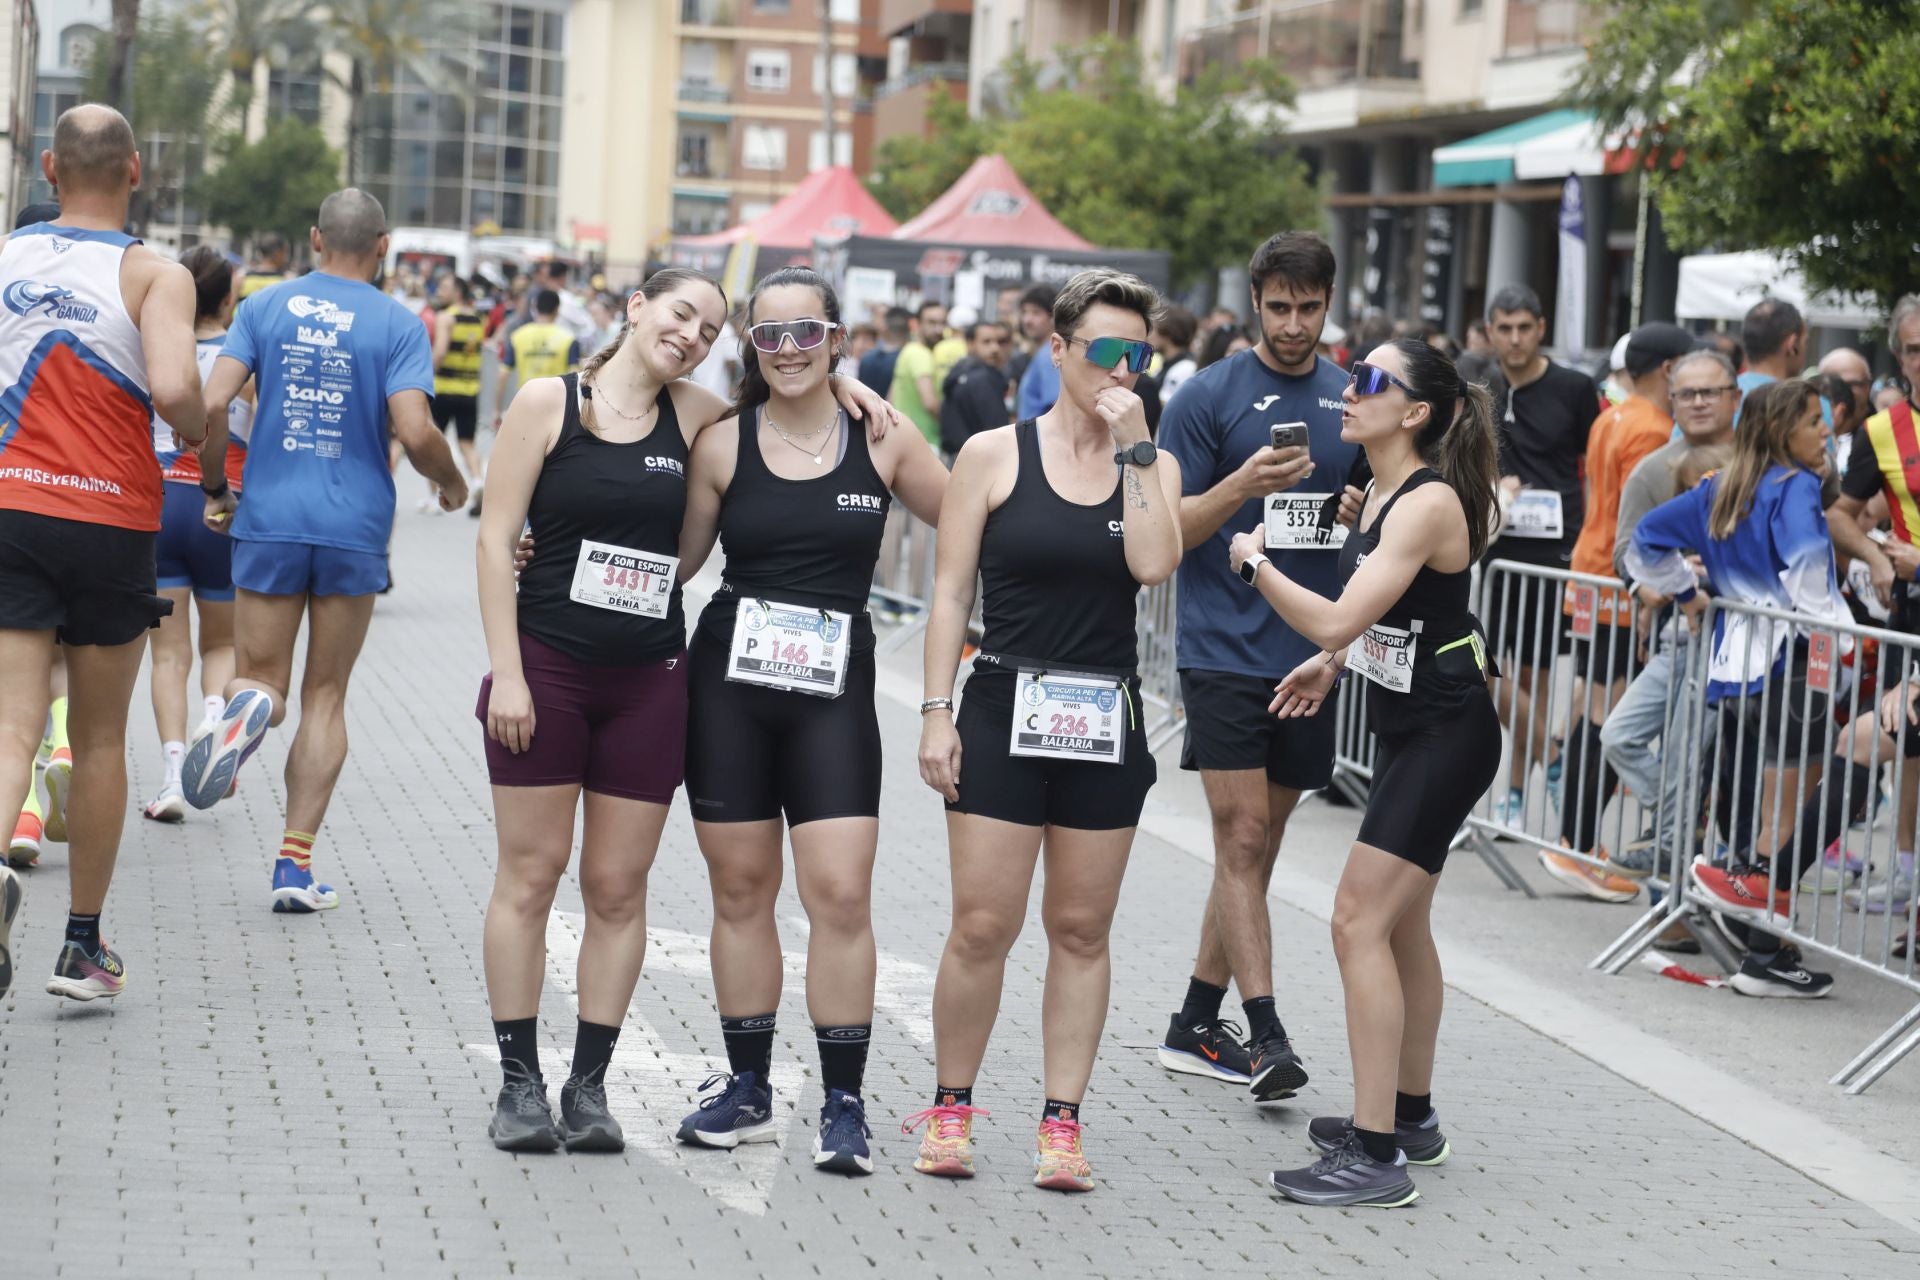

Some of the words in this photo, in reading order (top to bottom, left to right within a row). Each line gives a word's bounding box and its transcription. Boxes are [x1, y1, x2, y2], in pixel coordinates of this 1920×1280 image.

[57, 305, 98, 323] GANDIA
[298, 326, 338, 340] MAX
[644, 456, 683, 475] CREW
[837, 493, 882, 509] CREW
[1292, 500, 1310, 509] SOM
[1287, 511, 1320, 527] 352
[613, 556, 635, 569] SOM
[637, 560, 668, 575] ESPORT
[603, 565, 650, 592] 3431
[660, 581, 667, 591] P
[804, 617, 819, 625] PEU
[783, 628, 802, 637] VIVES
[1375, 632, 1406, 647] ESPORT
[745, 638, 758, 654] P
[772, 639, 809, 665] 146
[1397, 654, 1406, 665] S
[1047, 686, 1075, 694] CIRCUIT
[1051, 693, 1076, 701] MARINA
[1026, 713, 1039, 730] C
[1049, 713, 1089, 736] 236
[939, 1087, 966, 1095] KIPRUN
[1049, 1102, 1076, 1110] KIPRUN
